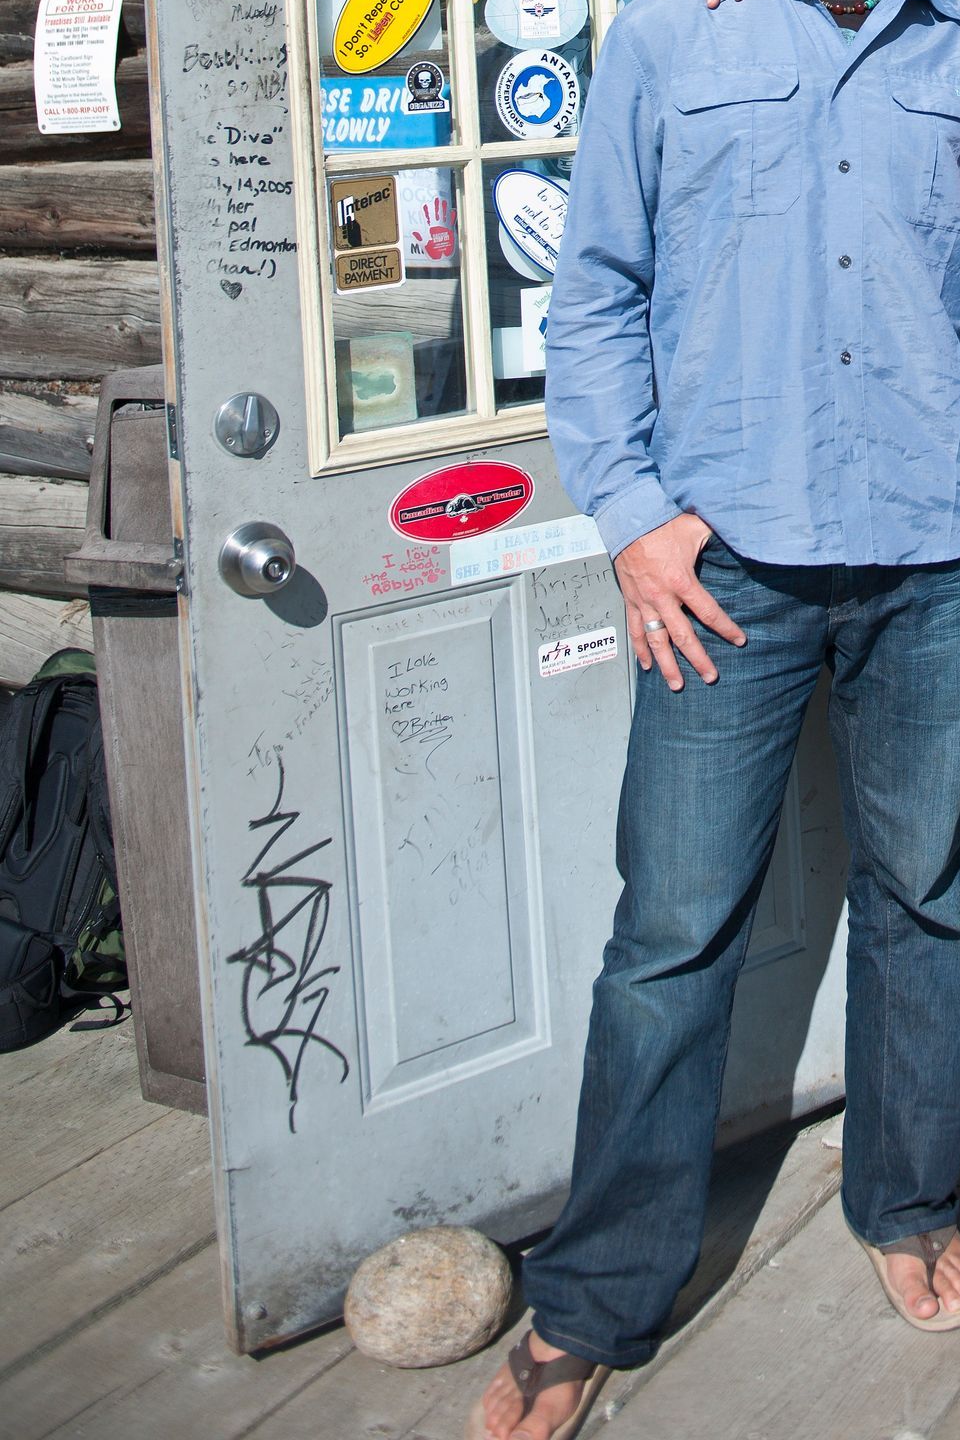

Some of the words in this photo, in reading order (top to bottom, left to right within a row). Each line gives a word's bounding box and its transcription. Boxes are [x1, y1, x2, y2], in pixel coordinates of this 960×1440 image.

[55, 5, 75, 13] FOR
[77, 3, 104, 12] FOOD
[88, 15, 111, 23] Available
[344, 23, 367, 51] Don't
[355, 44, 372, 58] So,
[367, 12, 394, 42] Listen
[503, 72, 525, 128] EXPEDITIONS
[540, 53, 577, 131] ANTARCTICA
[44, 107, 60, 115] CALL
[229, 152, 271, 167] here
[227, 198, 254, 214] her
[521, 204, 536, 220] not
[228, 217, 257, 238] pal
[229, 237, 298, 252] Edmonton
[350, 255, 388, 271] DIRECT
[345, 267, 395, 284] PAYMENT
[400, 505, 444, 521] Canadian
[505, 530, 539, 548] HAVE
[382, 554, 395, 569] I
[406, 546, 441, 560] love
[455, 563, 481, 580] SHE
[486, 559, 500, 573] IS
[501, 547, 537, 570] BIG
[538, 545, 564, 561] AND
[362, 571, 388, 585] the
[371, 578, 424, 596] Robyn
[577, 636, 615, 653] SPORTS
[388, 662, 403, 679] I
[407, 652, 438, 672] Love
[385, 678, 448, 698] working
[385, 701, 415, 714] here
